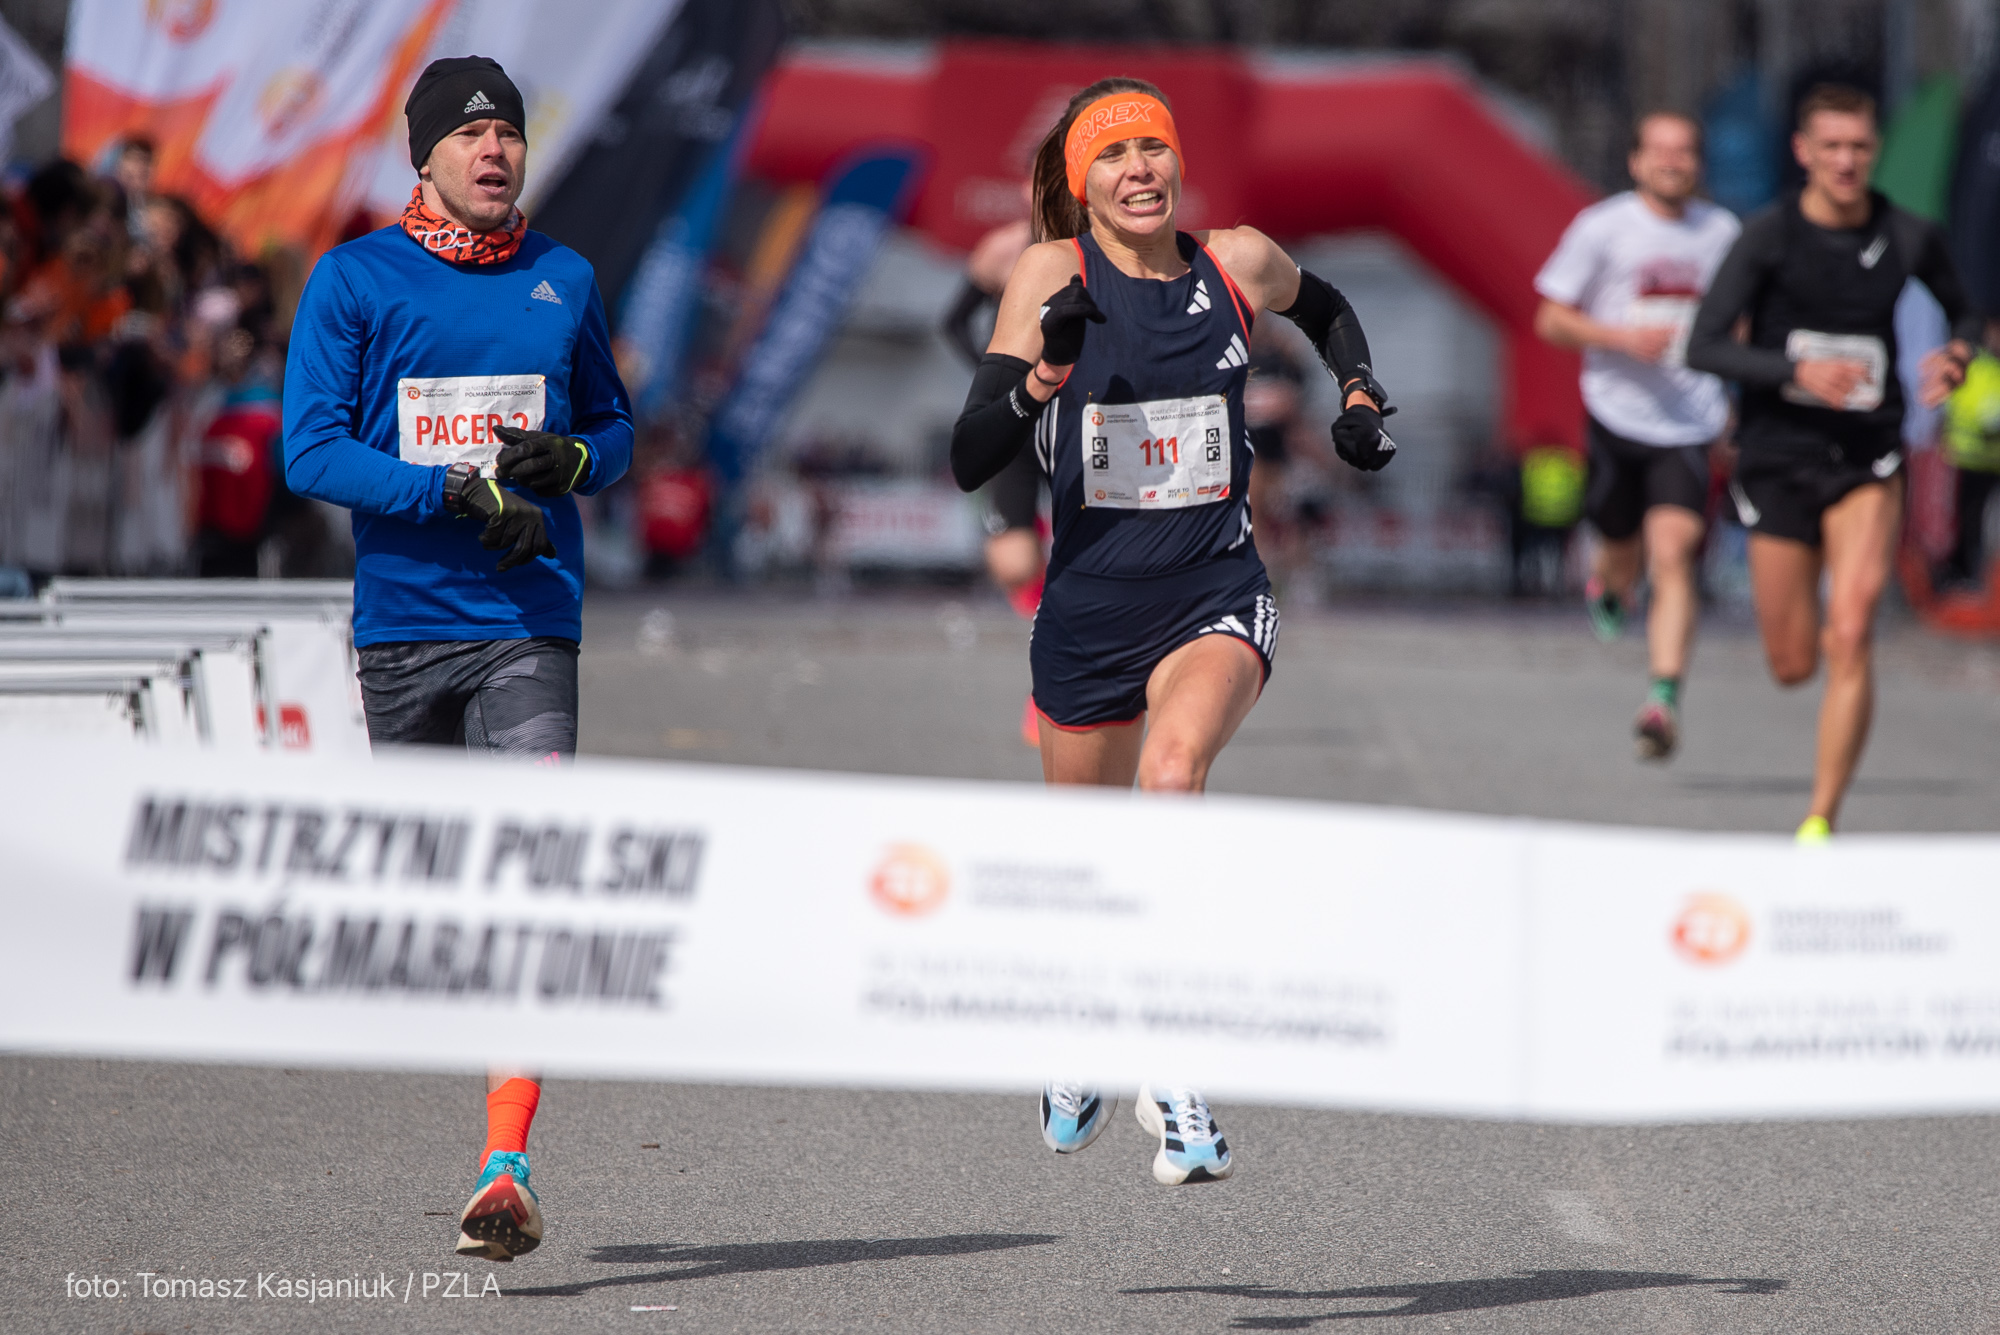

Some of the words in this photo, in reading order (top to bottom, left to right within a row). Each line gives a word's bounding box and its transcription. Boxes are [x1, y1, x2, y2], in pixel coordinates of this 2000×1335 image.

[464, 103, 495, 114] adidas
[1068, 101, 1155, 175] TERREX
[531, 292, 562, 305] adidas
[416, 413, 504, 446] PACER
[1139, 436, 1178, 466] 111
[127, 797, 471, 883] MISTRZYNI
[485, 818, 707, 901] POLSKI
[128, 900, 194, 986] W
[203, 889, 680, 1011] PÓŁMARATONIE
